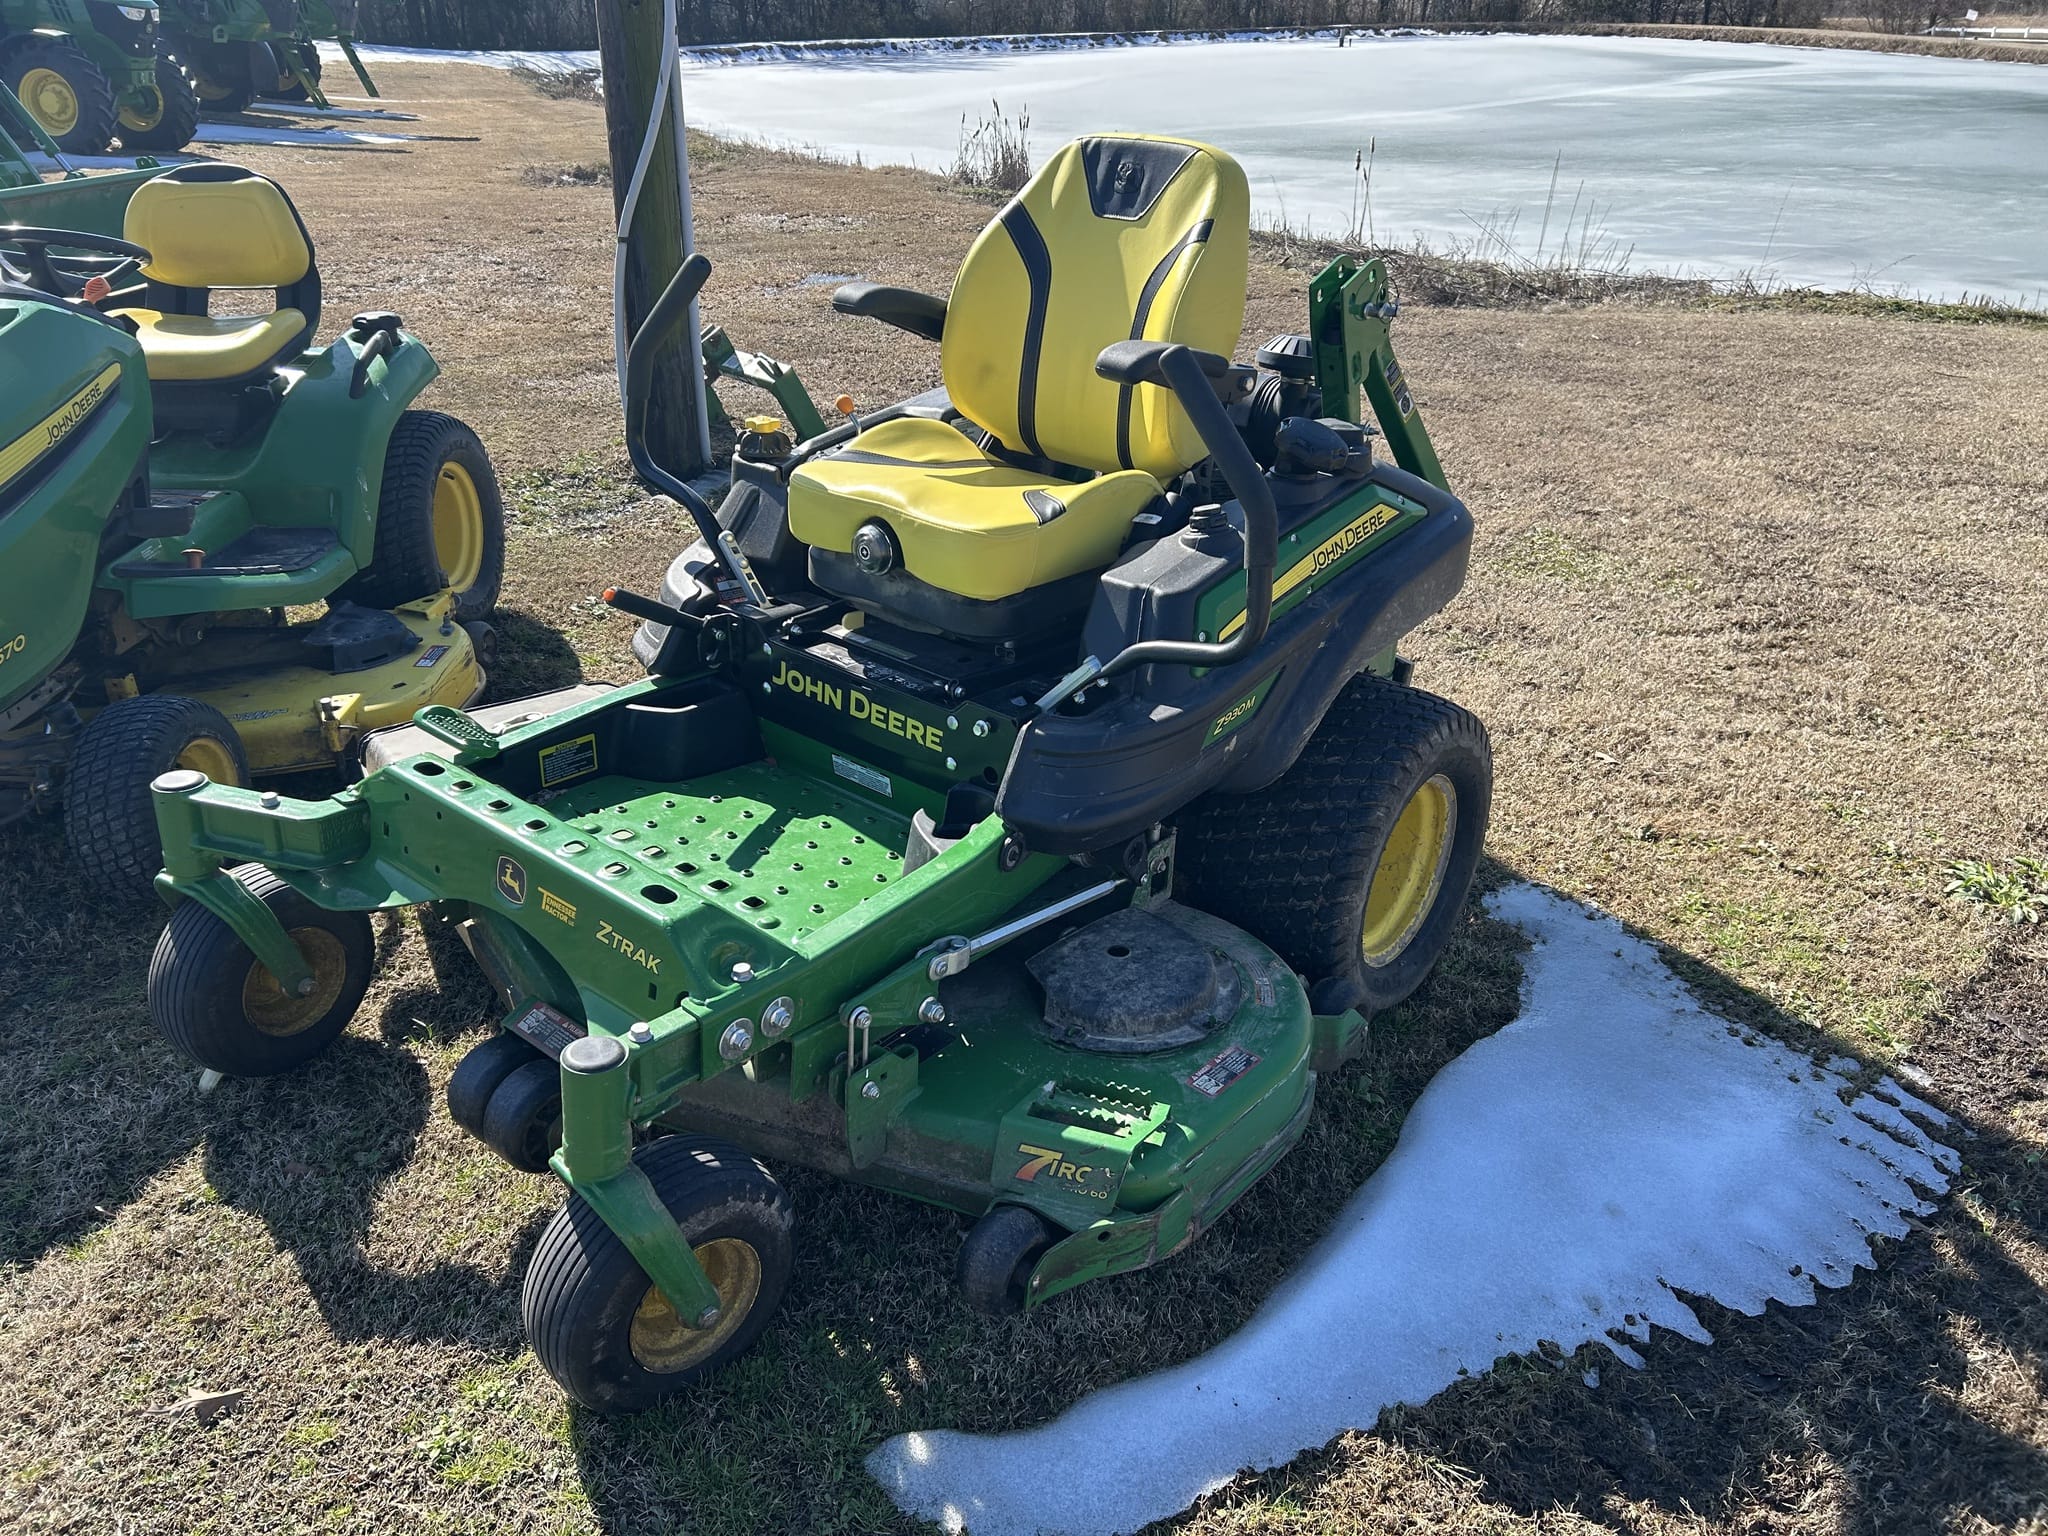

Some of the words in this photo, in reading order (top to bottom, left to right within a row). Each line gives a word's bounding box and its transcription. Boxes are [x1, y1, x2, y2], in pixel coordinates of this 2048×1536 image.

[46, 411, 75, 447] JOHN
[72, 383, 102, 419] DEERE
[1310, 538, 1345, 575] JOHN
[1345, 510, 1386, 549] DEERE
[772, 661, 842, 710] JOHN
[850, 690, 943, 753] DEERE
[1213, 695, 1256, 736] Z930M
[595, 920, 662, 975] ZTRAK
